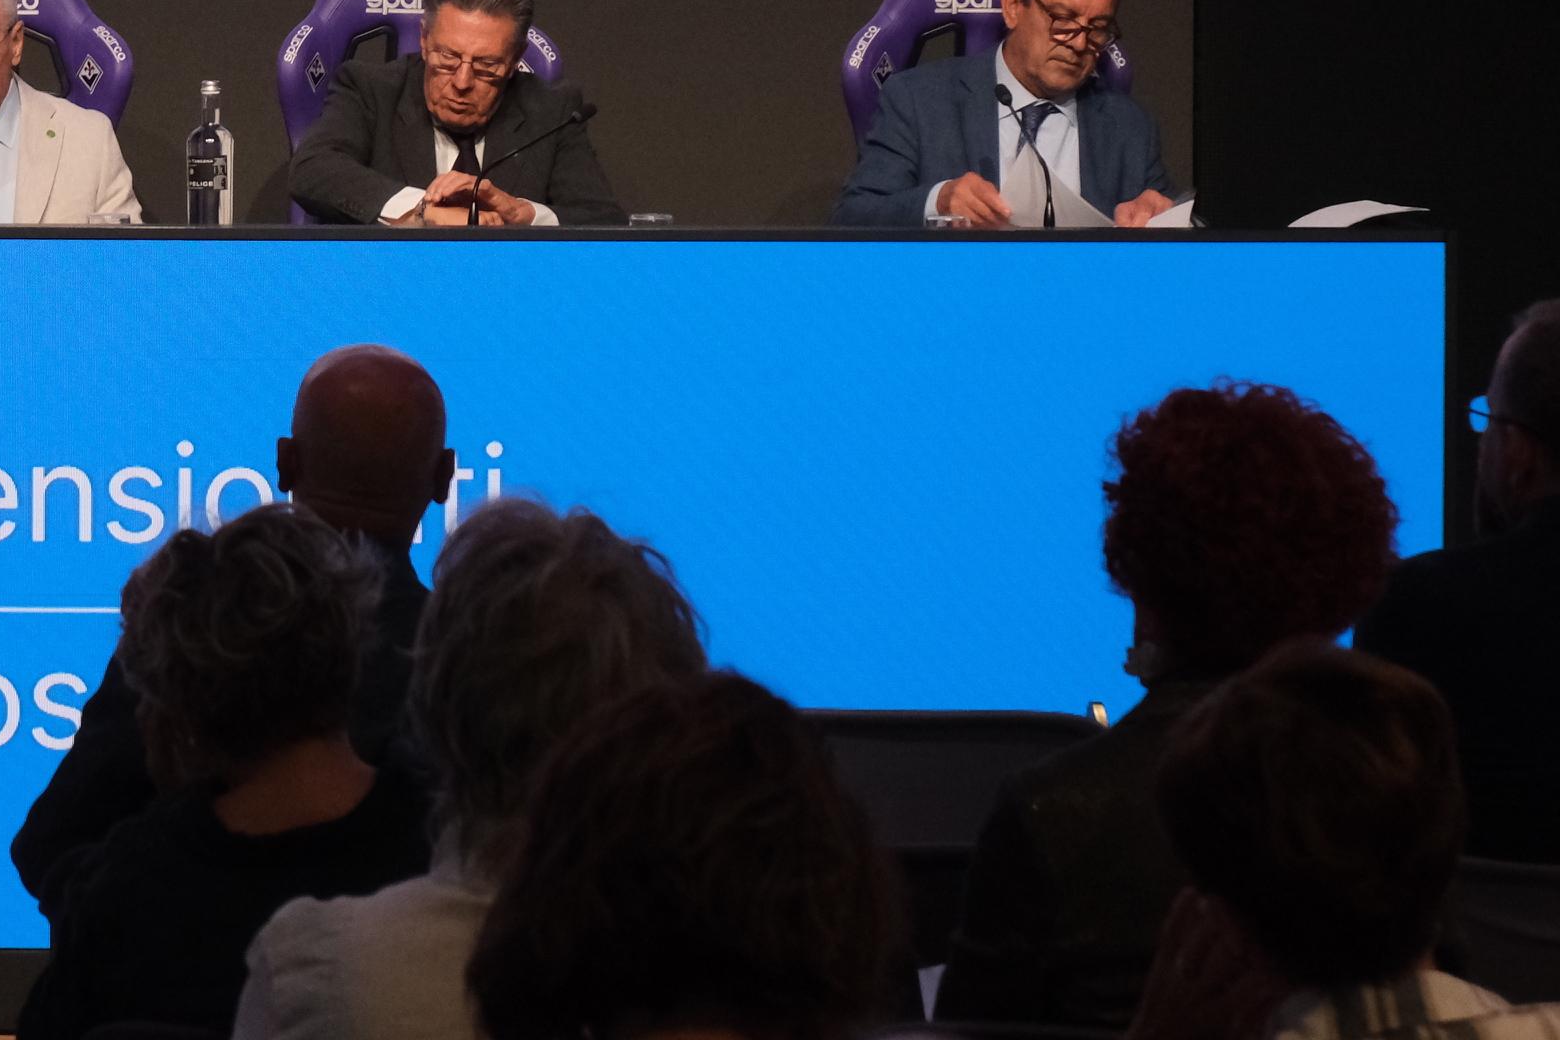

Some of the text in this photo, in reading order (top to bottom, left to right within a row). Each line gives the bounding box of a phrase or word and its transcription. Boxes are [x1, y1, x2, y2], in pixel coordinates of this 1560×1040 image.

[93, 25, 126, 64] sparco
[284, 24, 313, 64] sparco
[528, 28, 556, 63] parco
[849, 25, 880, 69] sparco
